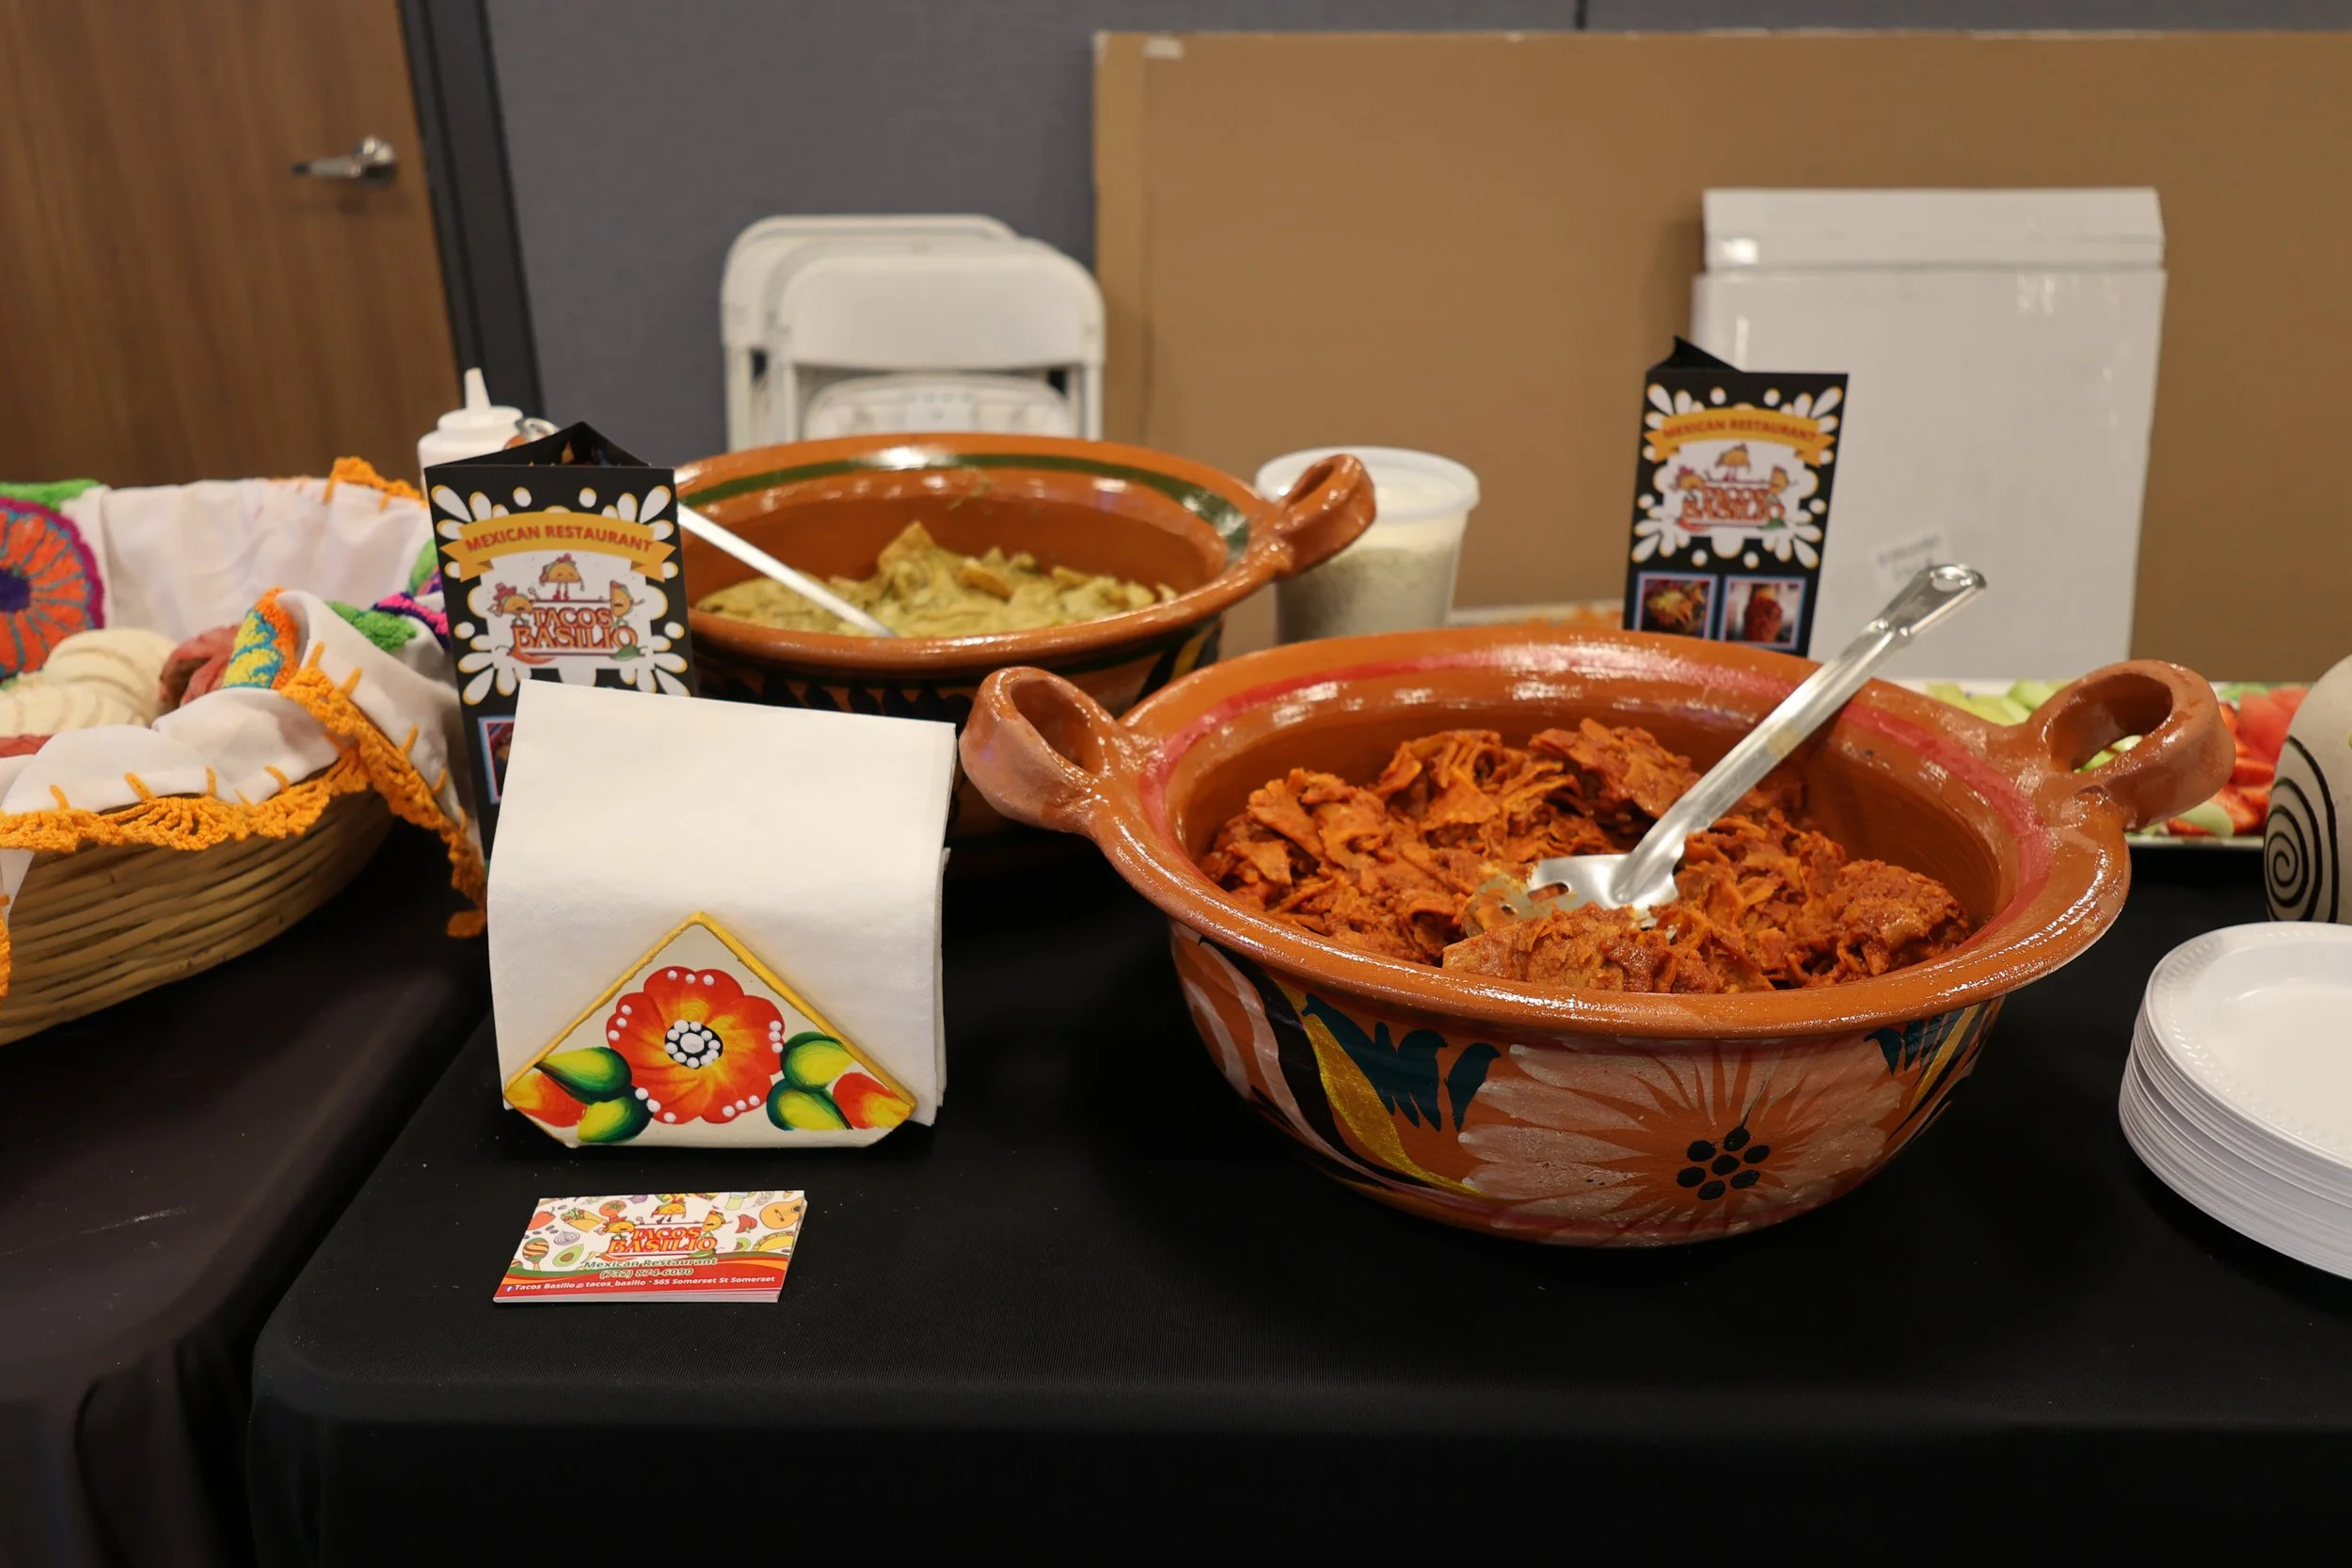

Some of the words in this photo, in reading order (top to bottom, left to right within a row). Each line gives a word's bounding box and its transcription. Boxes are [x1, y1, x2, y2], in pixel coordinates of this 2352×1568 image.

[466, 526, 541, 552] MEXICAN
[546, 525, 654, 553] RESTAURANT
[532, 606, 612, 627] TACOS
[511, 624, 639, 649] BASILIO
[633, 1227, 703, 1239] TACOS
[609, 1237, 718, 1252] BASILIO
[583, 1259, 641, 1269] Mexican
[643, 1257, 718, 1267] Restaurant
[599, 1269, 633, 1279] (732)
[635, 1268, 694, 1278] 874-6090
[585, 1279, 646, 1289] tacos_basilio
